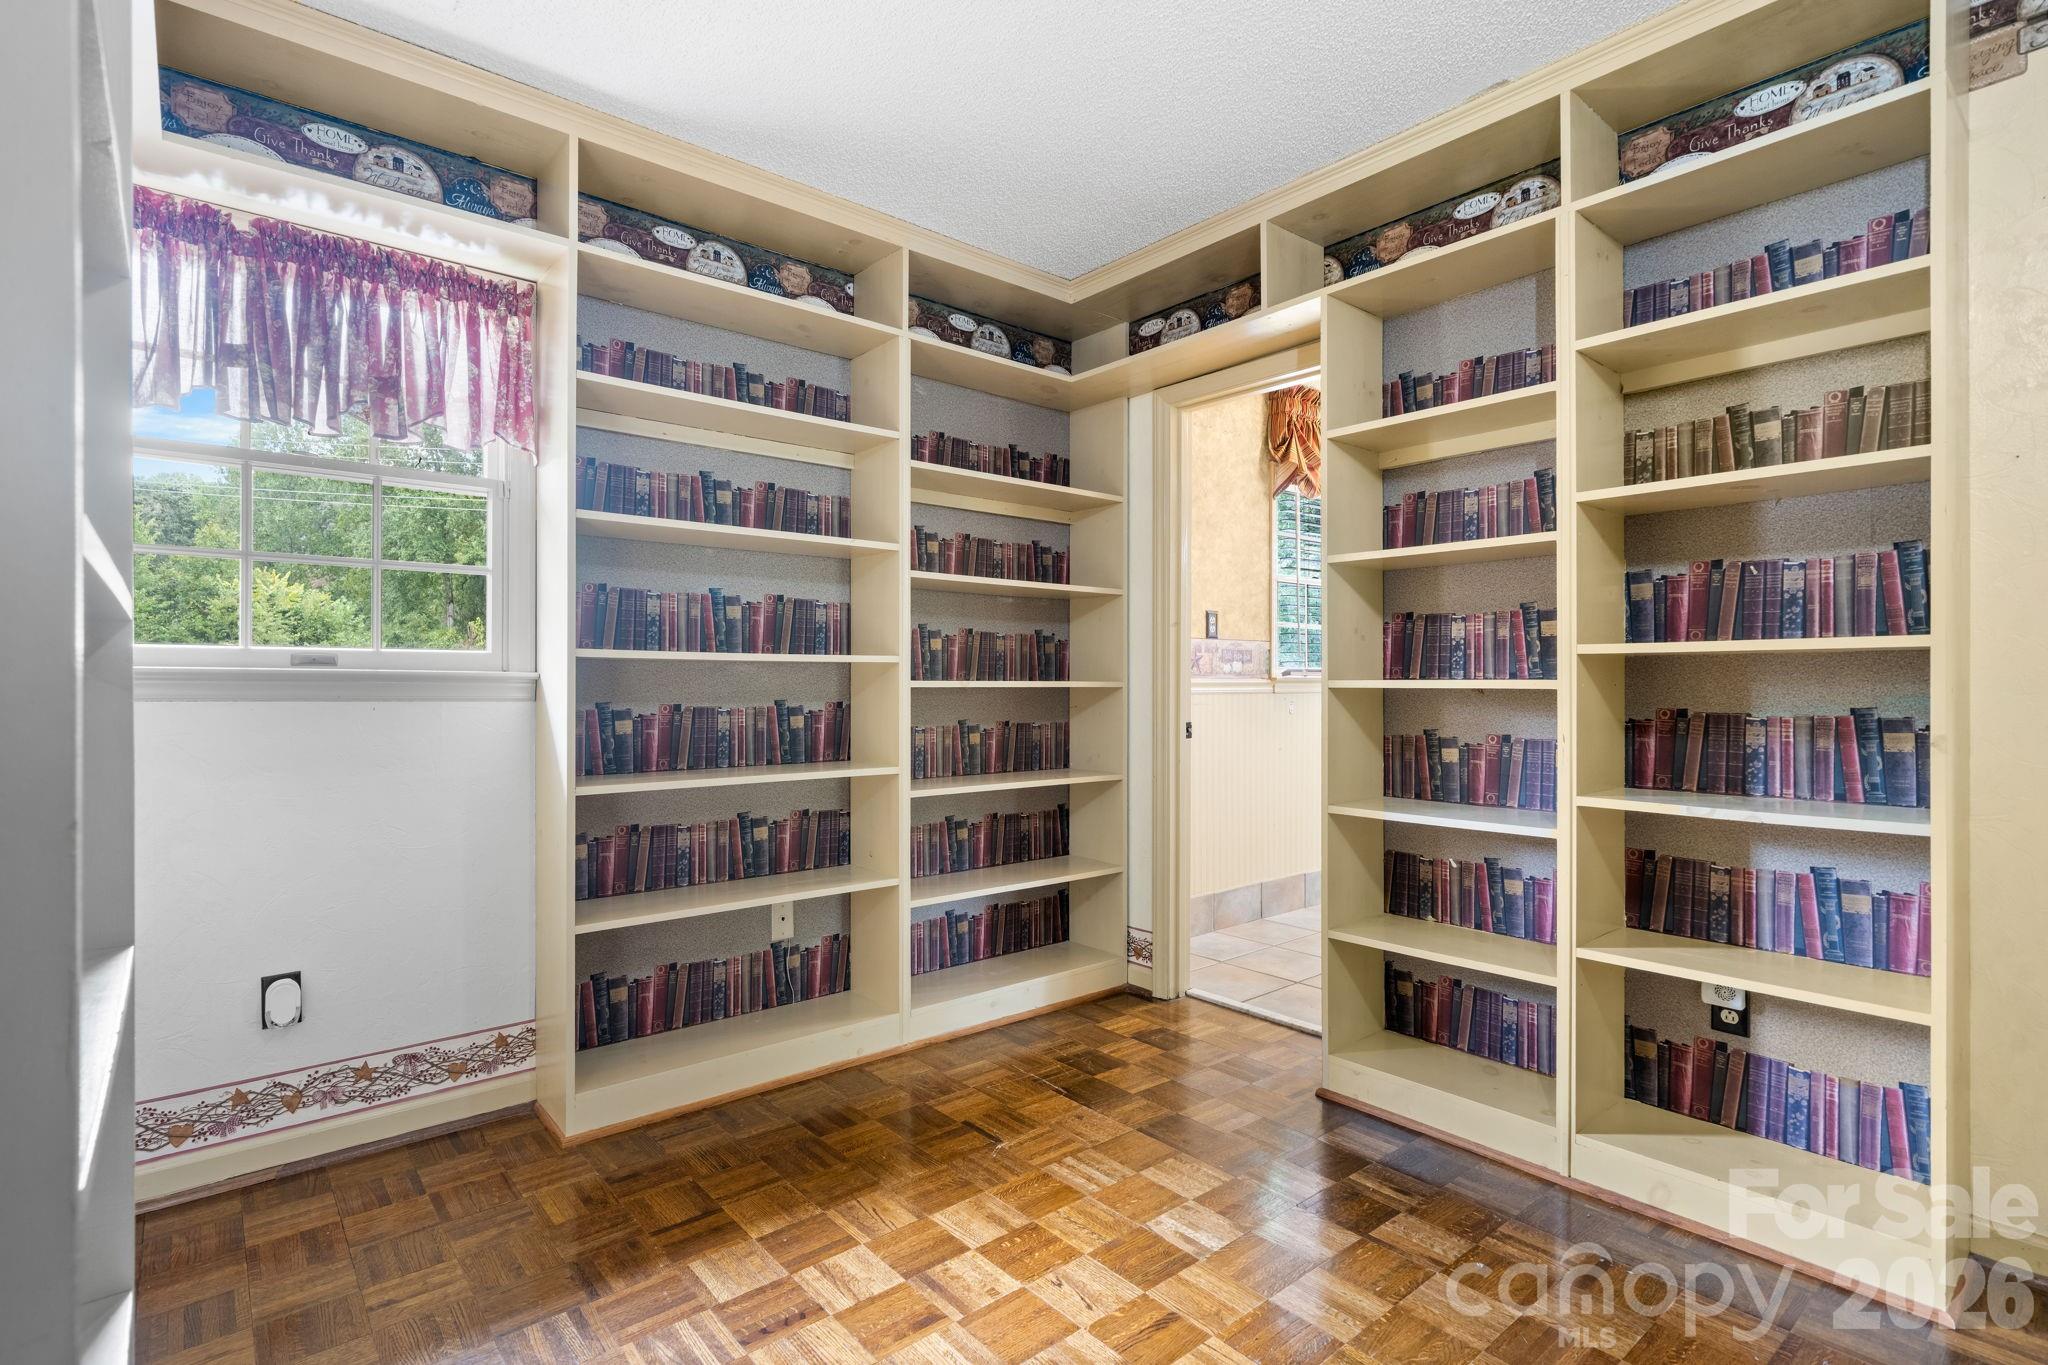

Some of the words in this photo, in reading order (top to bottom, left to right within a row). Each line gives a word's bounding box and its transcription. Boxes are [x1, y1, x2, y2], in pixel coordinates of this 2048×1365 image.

[1750, 84, 1791, 108] HOME
[253, 126, 287, 150] Give
[291, 134, 340, 164] Thanks
[316, 125, 354, 144] HOME
[1689, 135, 1720, 152] Give
[1724, 115, 1774, 141] Thanks
[445, 192, 496, 217] Always
[620, 230, 643, 248] Give
[645, 236, 678, 258] Thanks
[1422, 231, 1444, 246] Give
[1446, 218, 1481, 238] Thanks
[820, 288, 838, 304] Give
[840, 292, 854, 307] Tha
